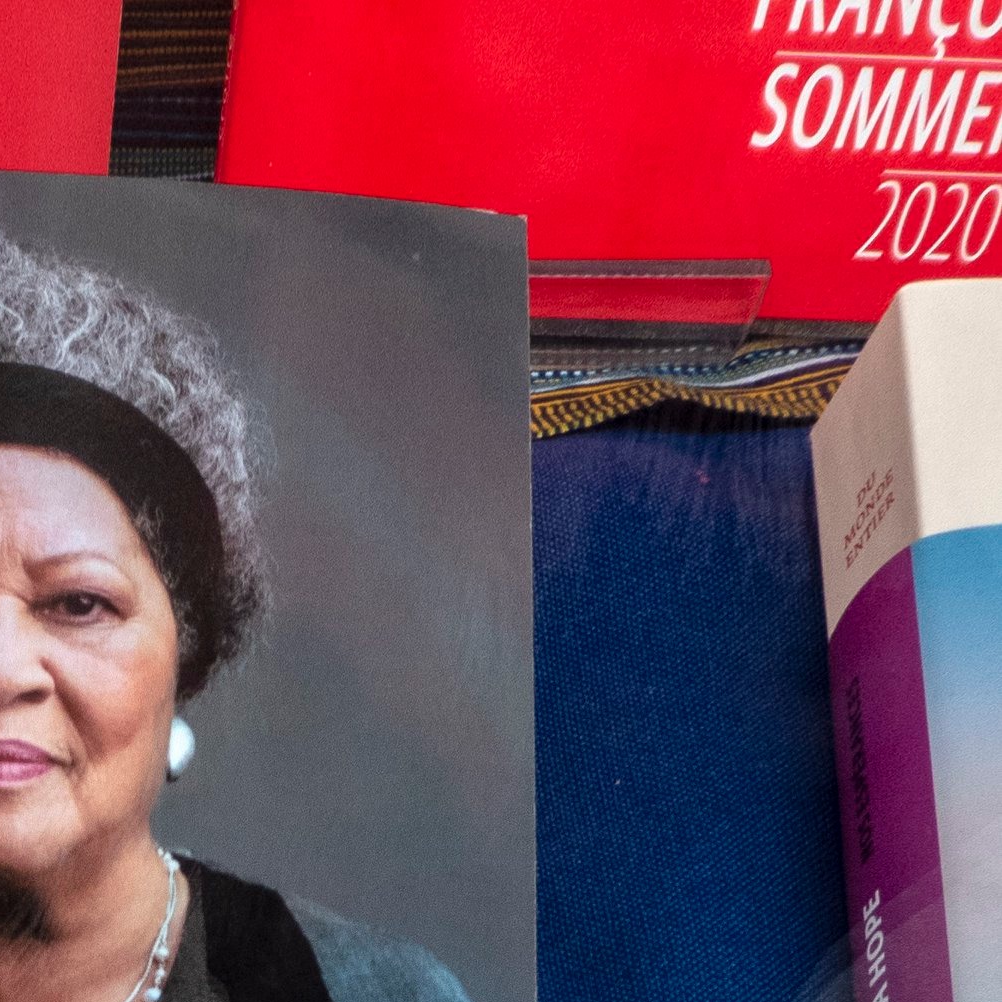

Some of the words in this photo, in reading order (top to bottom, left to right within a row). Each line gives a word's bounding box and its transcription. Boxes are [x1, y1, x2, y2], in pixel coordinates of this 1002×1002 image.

[750, 63, 1002, 155] SOMME
[852, 180, 1002, 263] 2020
[843, 467, 894, 551] MONDE
[845, 491, 895, 570] ENTIER
[856, 471, 875, 508] DU
[863, 889, 886, 988] HOPE
